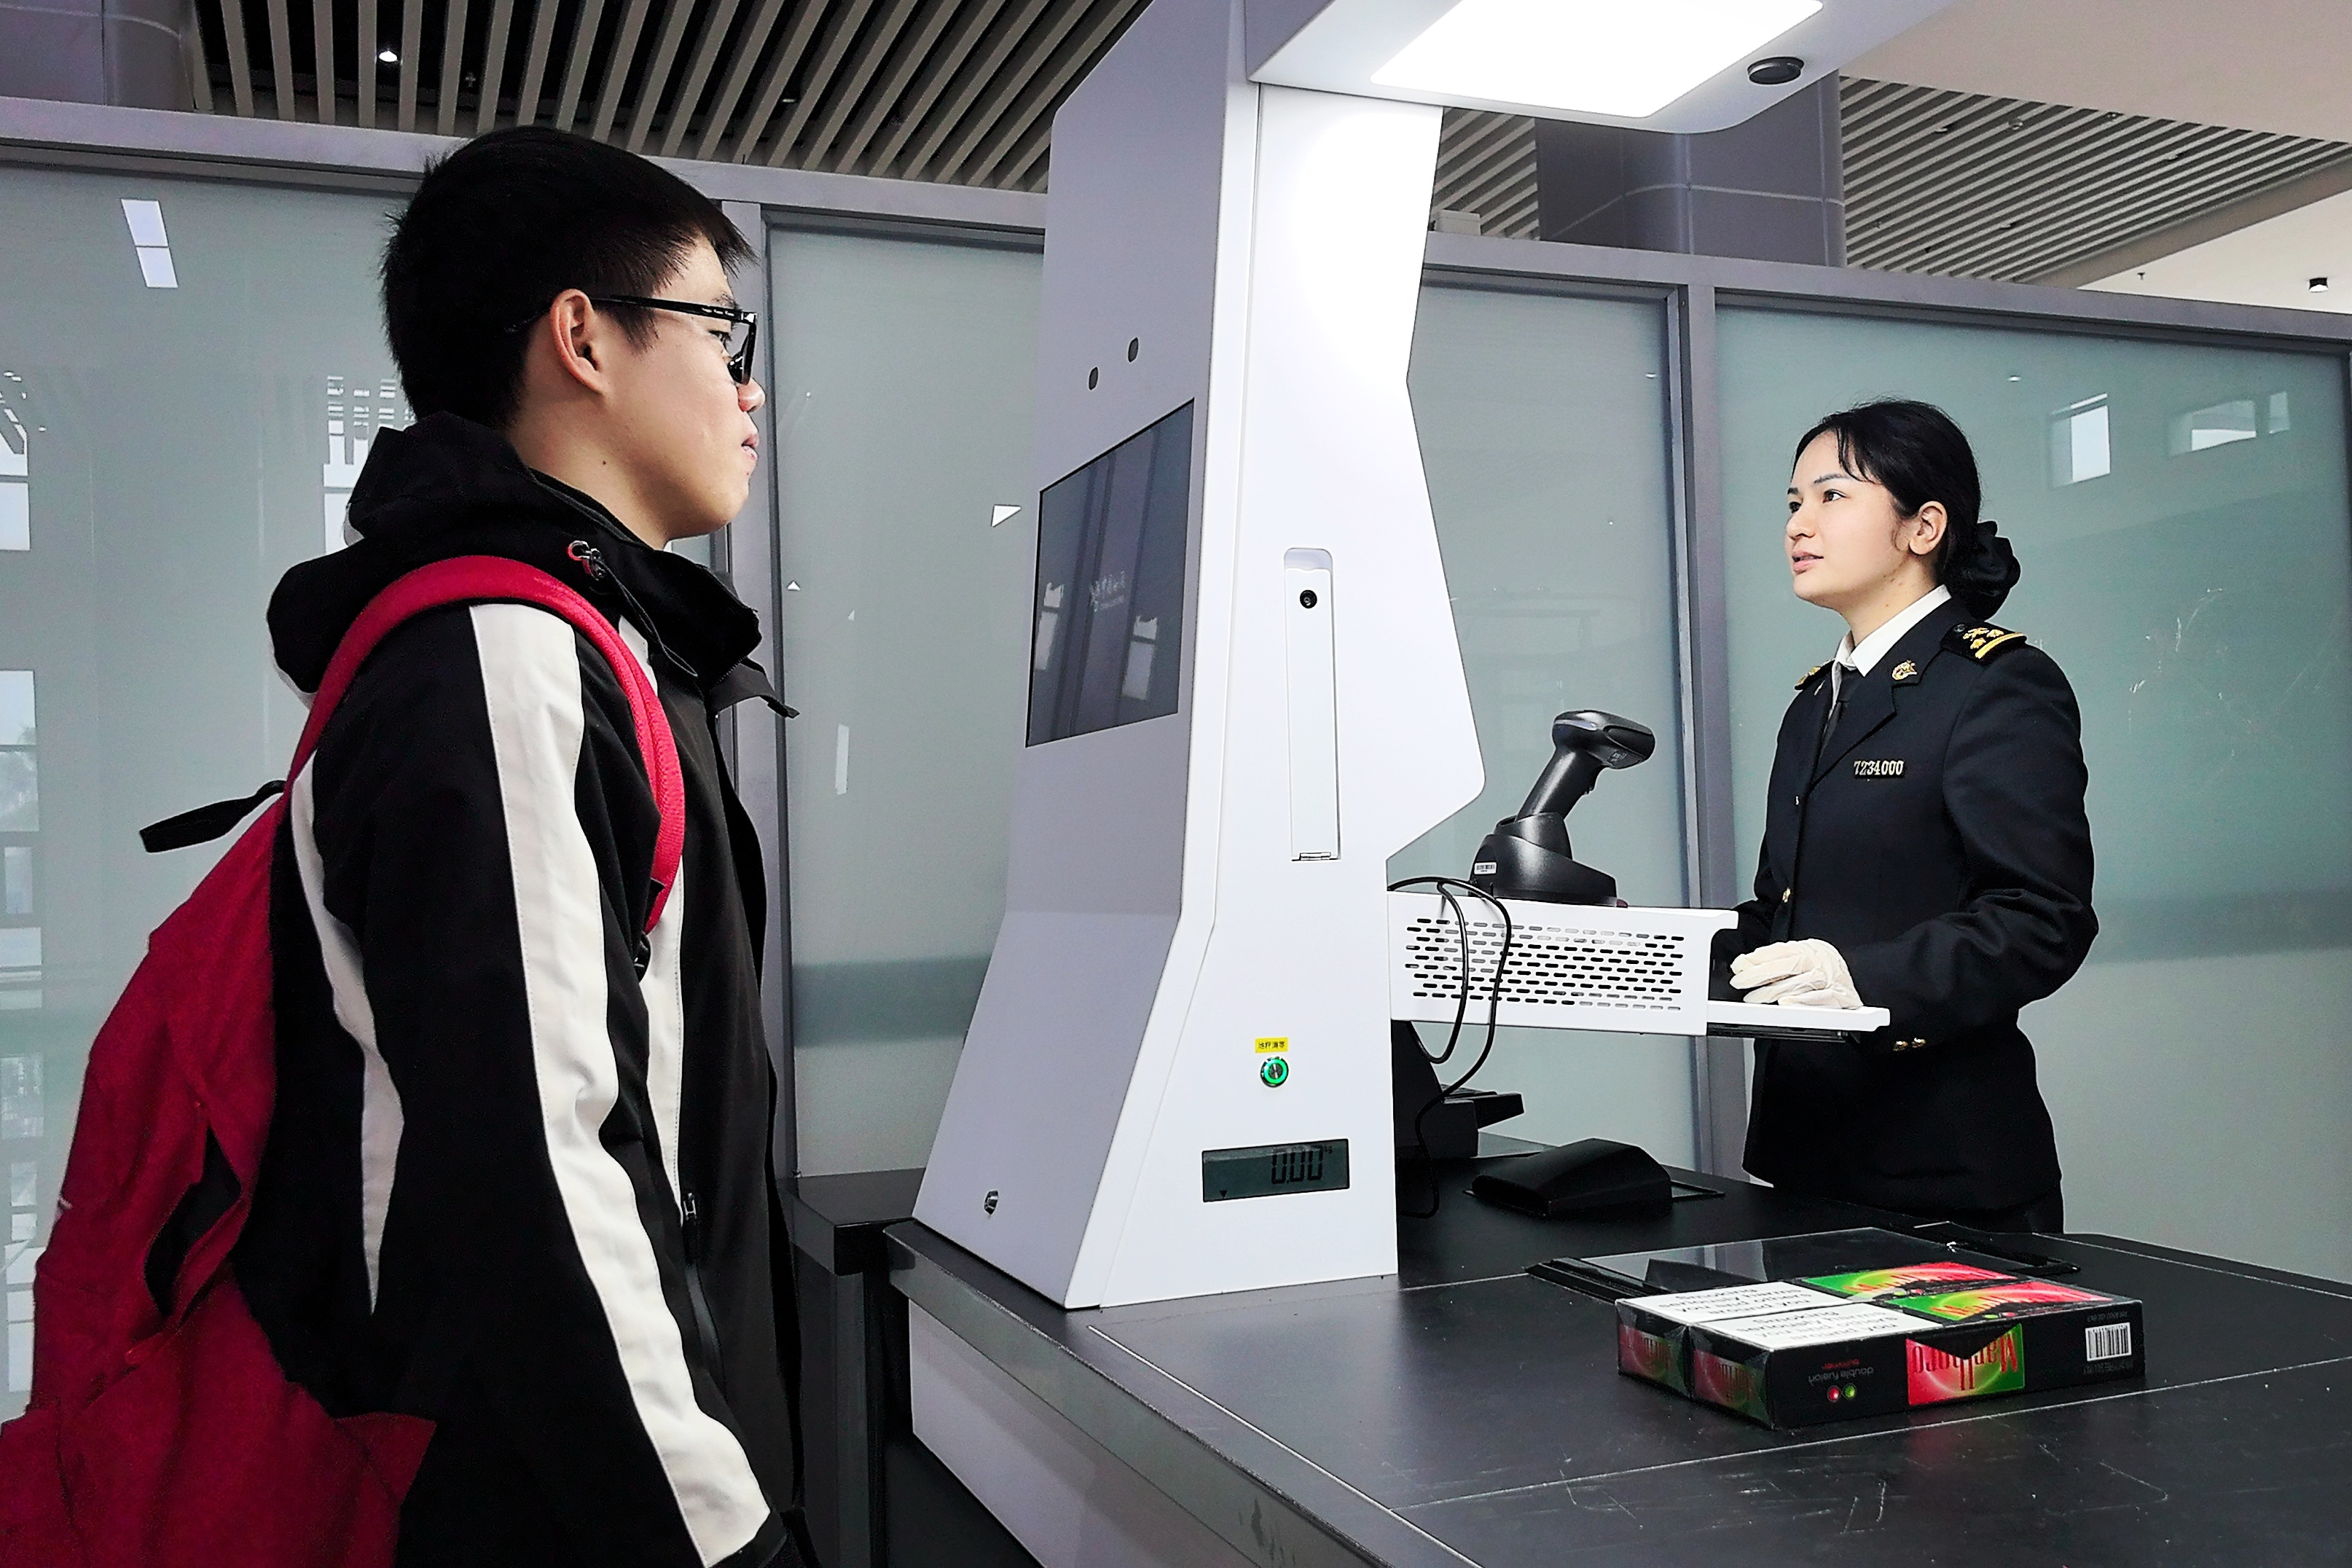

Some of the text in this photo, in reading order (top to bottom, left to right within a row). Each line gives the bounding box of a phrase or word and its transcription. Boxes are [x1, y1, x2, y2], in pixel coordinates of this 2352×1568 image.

[1854, 760, 1905, 776] 7234000
[1271, 1145, 1323, 1184] 0.00
[1659, 1290, 1802, 1308] seriously harms
[1676, 1289, 1757, 1299] Smoking
[1675, 1305, 1709, 1313] you
[1754, 1293, 1812, 1302] others
[1709, 1304, 1772, 1314] around
[1736, 1312, 1886, 1332] seriously harms
[1753, 1311, 1839, 1323] Smoking
[1755, 1315, 1898, 1338] you and others
[1790, 1322, 1897, 1339] around you
[1841, 1367, 1874, 1379] double
